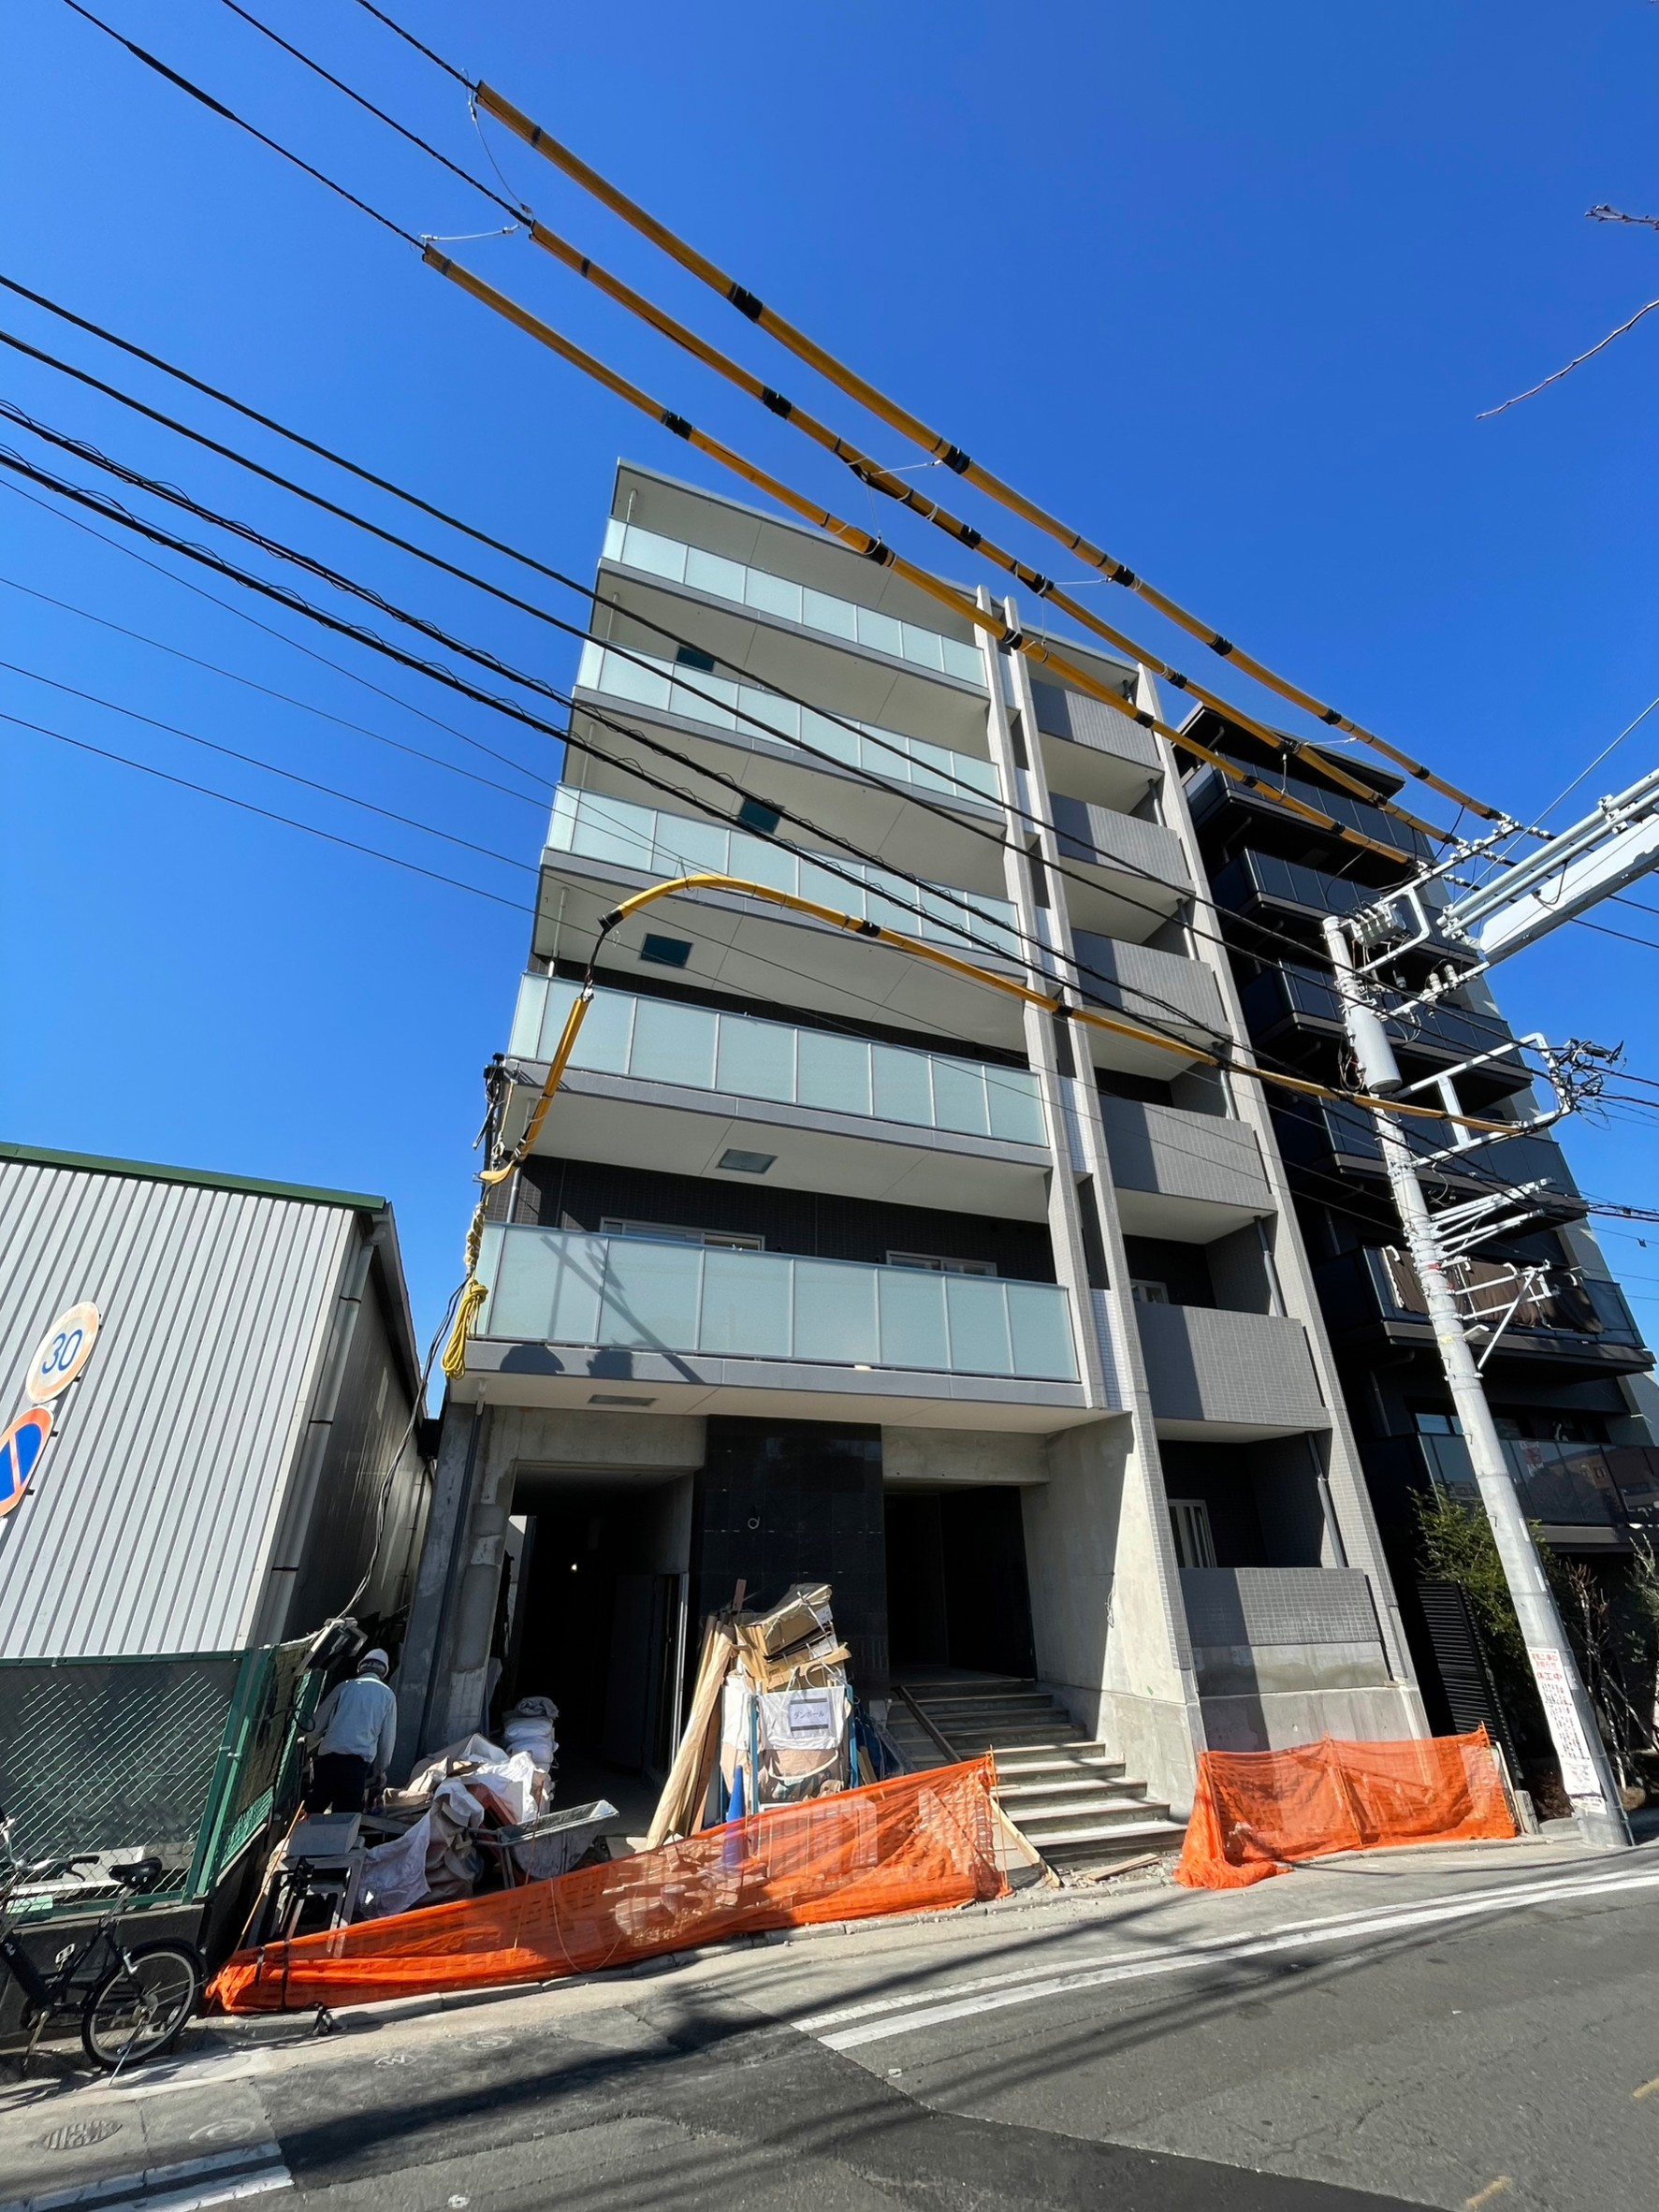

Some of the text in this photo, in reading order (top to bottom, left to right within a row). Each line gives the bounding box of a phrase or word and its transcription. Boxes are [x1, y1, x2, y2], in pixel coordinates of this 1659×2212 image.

[42, 1329, 82, 1375] 30
[793, 1710, 825, 1720] ダンボール
